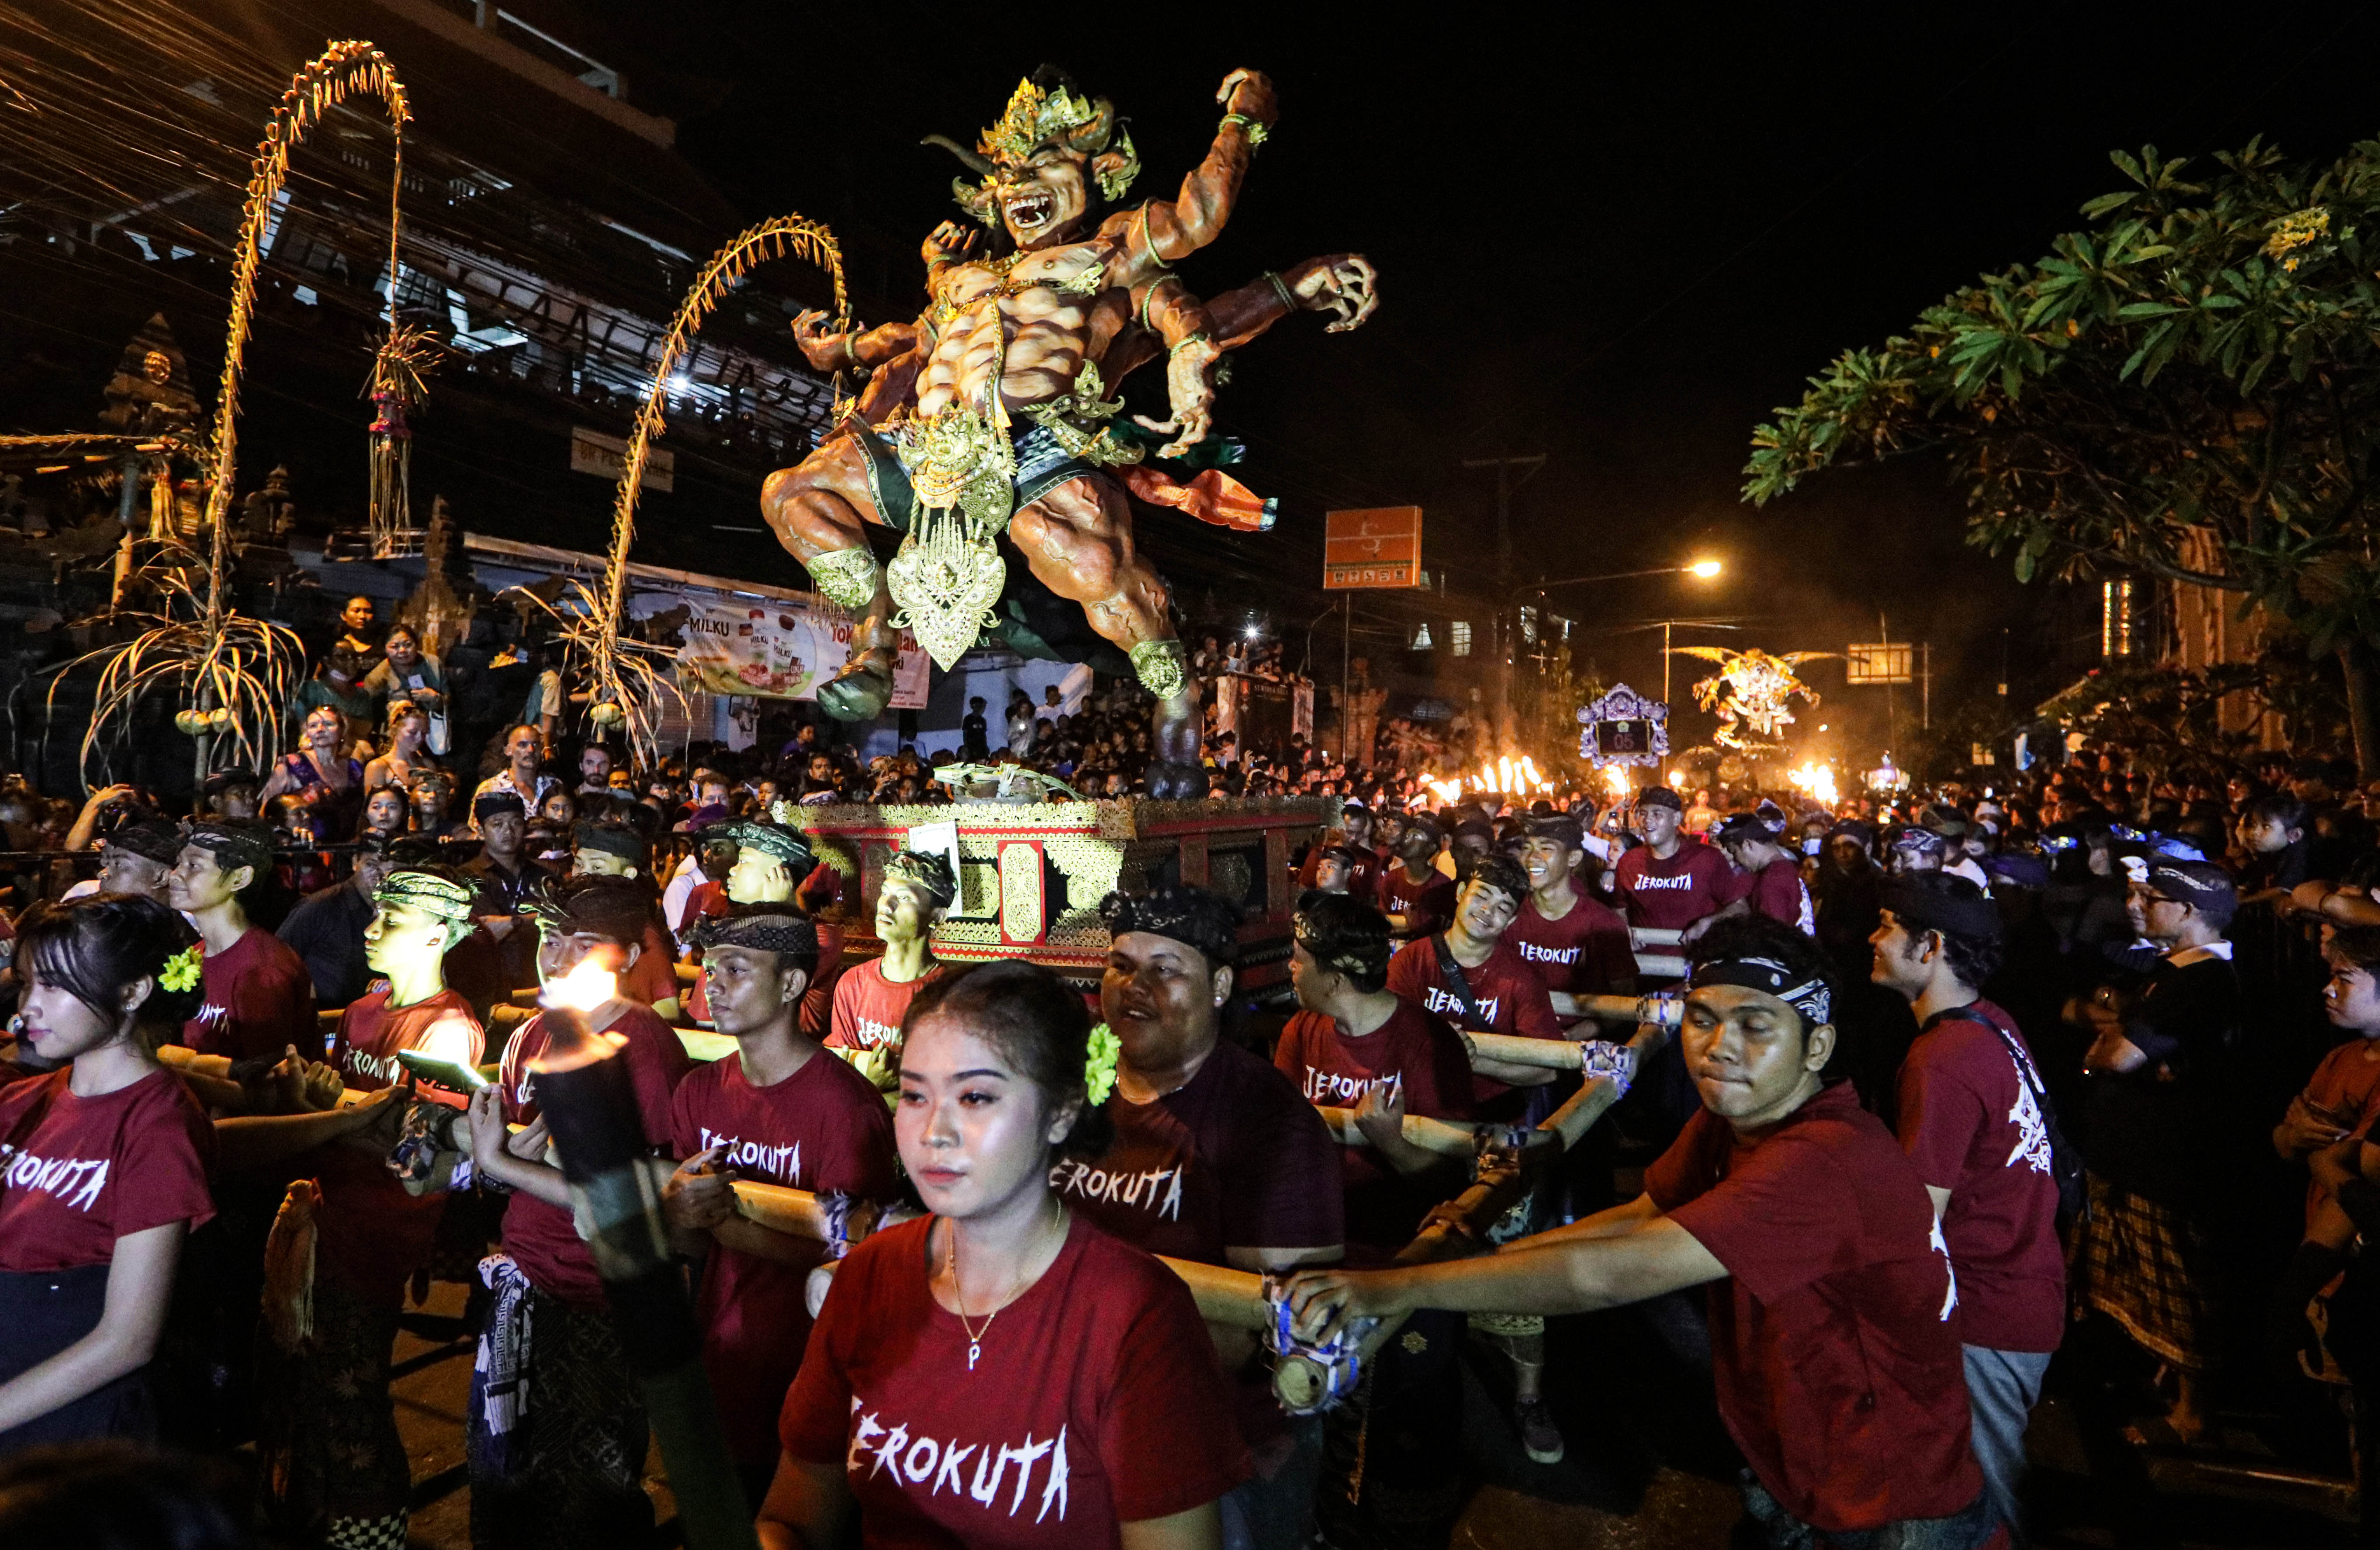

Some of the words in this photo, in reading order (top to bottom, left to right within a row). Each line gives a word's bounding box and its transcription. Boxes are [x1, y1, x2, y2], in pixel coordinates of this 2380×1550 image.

[690, 618, 729, 637] MILKU
[751, 636, 768, 644] MILKU
[774, 644, 792, 657] MILKU
[1614, 733, 1634, 750] 05
[1634, 872, 1692, 891] JEROKUTA
[1049, 1158, 1183, 1222] EROKUTA
